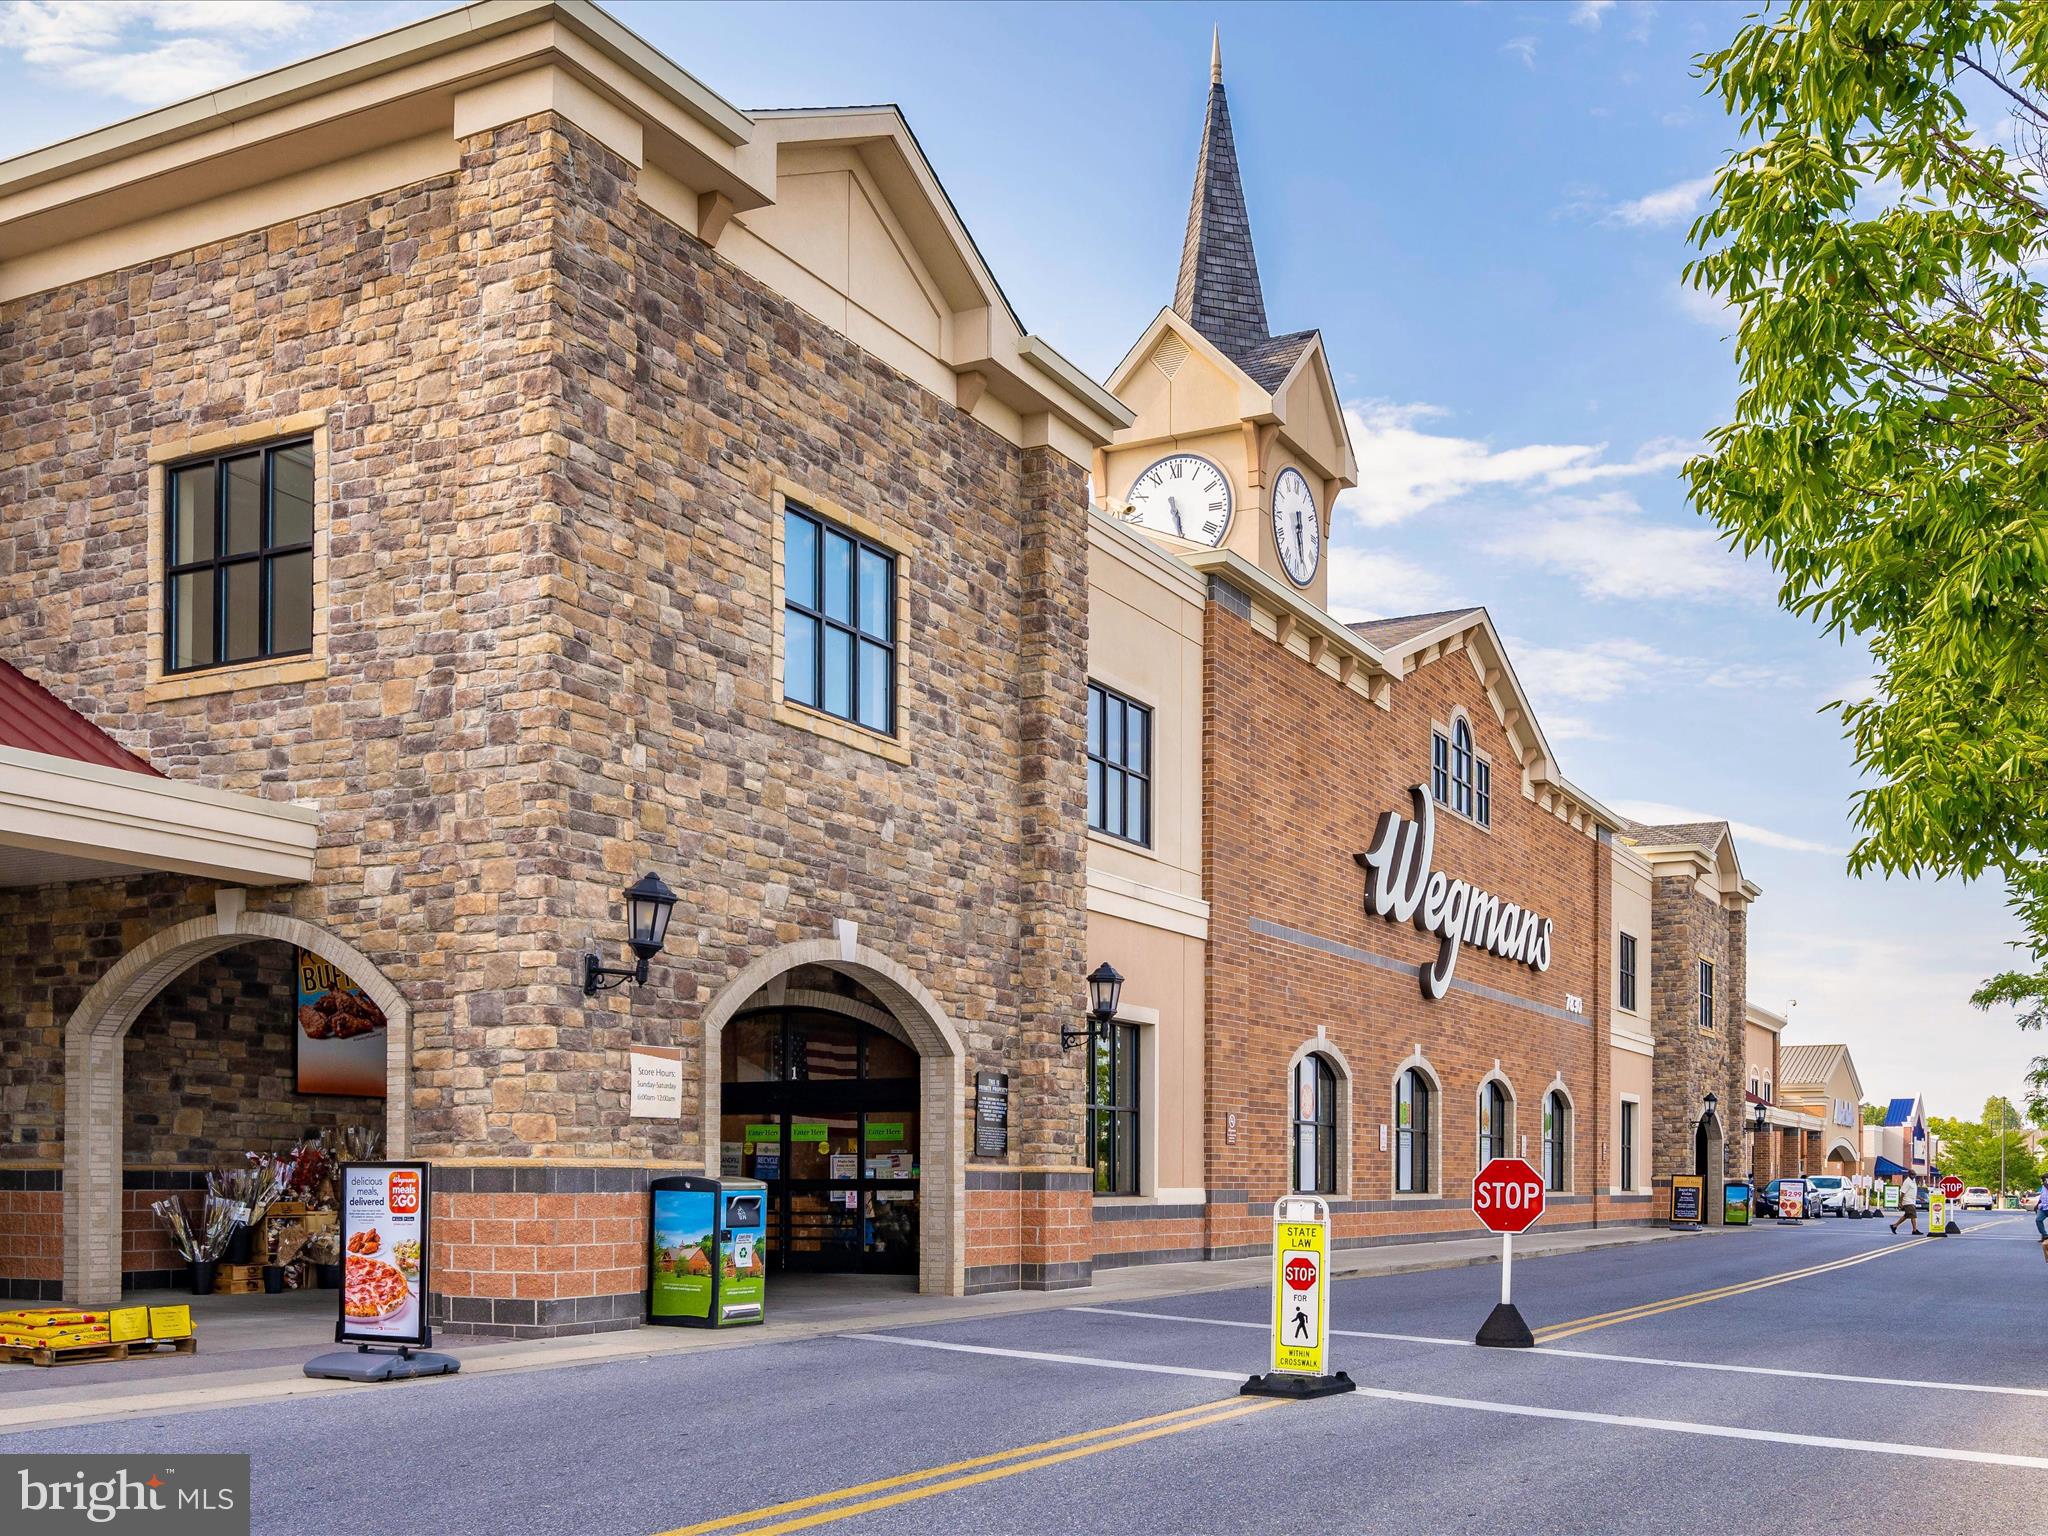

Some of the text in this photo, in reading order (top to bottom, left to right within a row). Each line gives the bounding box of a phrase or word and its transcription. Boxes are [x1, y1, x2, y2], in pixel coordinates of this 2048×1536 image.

[1354, 783, 1553, 1000] Wegmans
[638, 1067, 677, 1078] Store Hours:
[791, 1066, 798, 1080] 1
[351, 1176, 383, 1186] delicious
[357, 1187, 379, 1196] meals,
[392, 1184, 416, 1194] meals
[1940, 1183, 1962, 1192] STOP
[1477, 1181, 1540, 1209] STOP
[349, 1197, 385, 1206] delivered
[392, 1194, 416, 1207] 2GO
[1287, 1227, 1317, 1237] STATE
[1291, 1238, 1312, 1248] LAW
[1286, 1267, 1316, 1281] STOP
[1293, 1294, 1308, 1302] FOR
[1288, 1349, 1310, 1357] WITHIN
[1280, 1358, 1318, 1367] CROSSWALK
